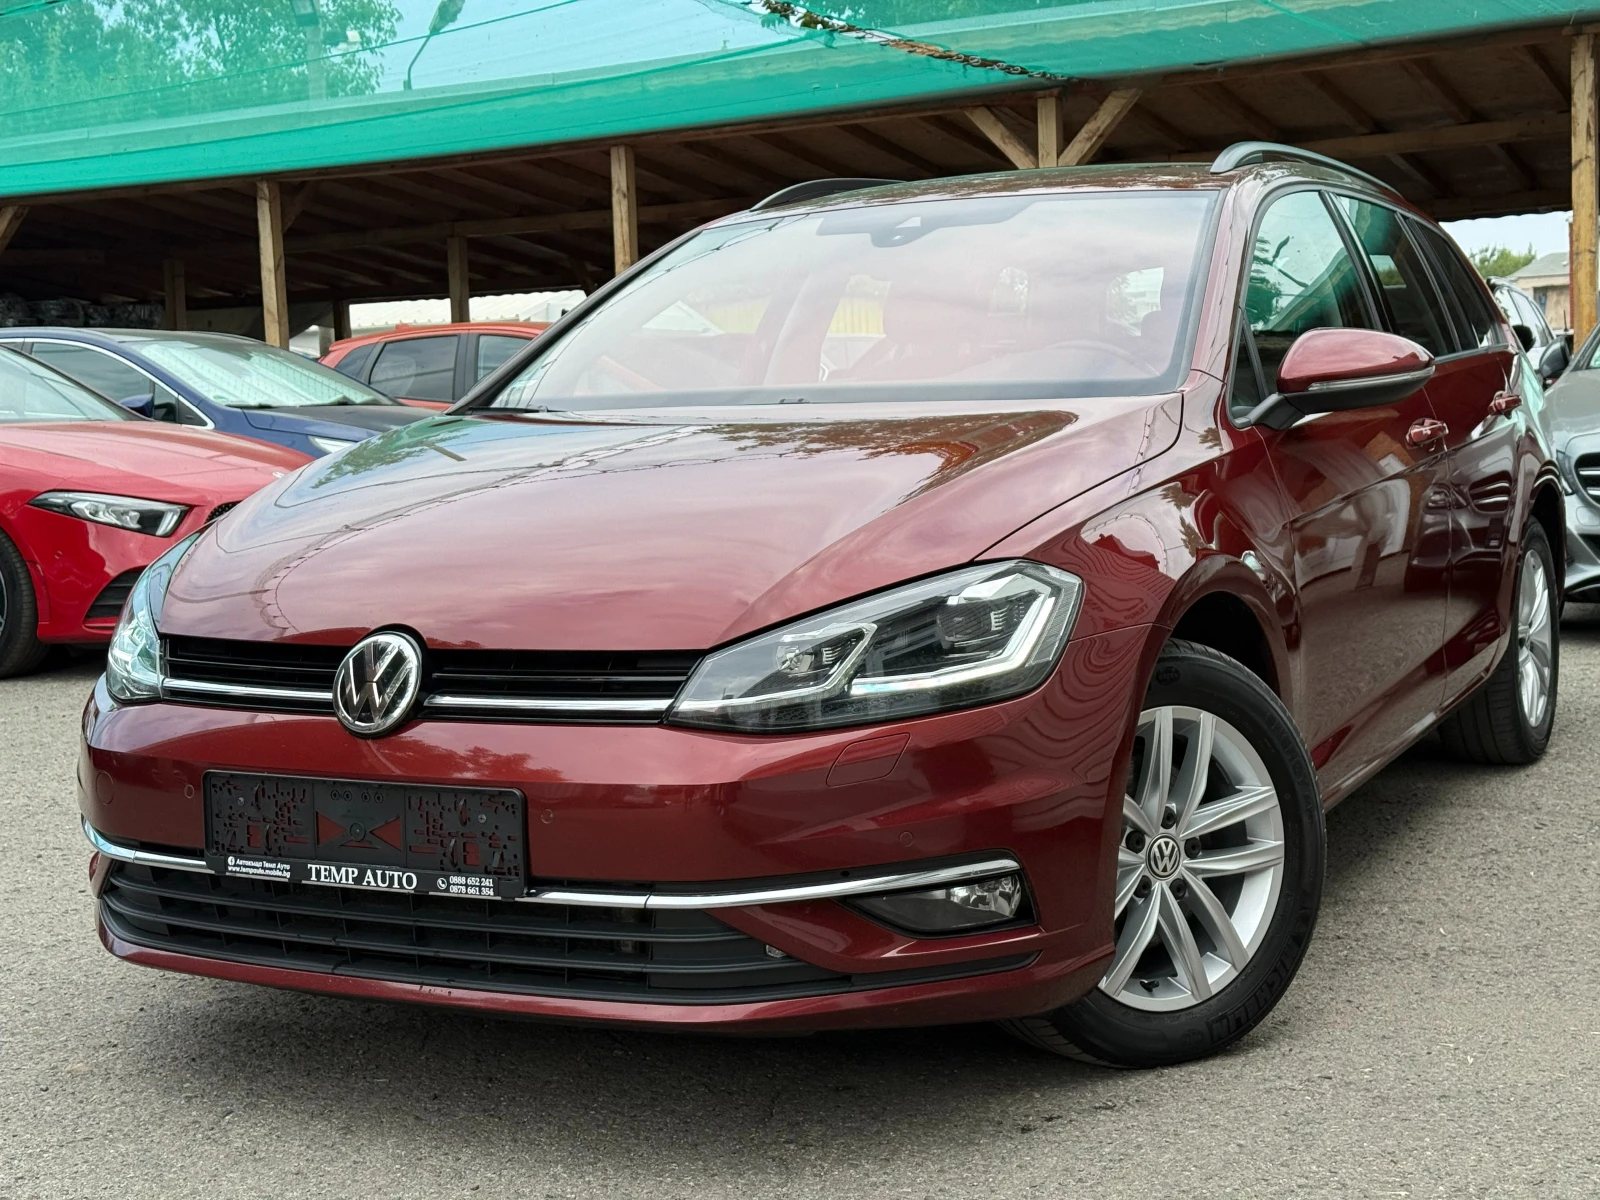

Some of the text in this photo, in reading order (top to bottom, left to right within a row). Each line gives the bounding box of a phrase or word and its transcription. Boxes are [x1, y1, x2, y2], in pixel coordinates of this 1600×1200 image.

[332, 631, 422, 733] VW
[1149, 837, 1180, 876] VW
[228, 866, 290, 878] www.tempauto.mobile.bg
[308, 864, 417, 890] TEMP AUTO
[450, 876, 493, 886] 0888 652 241
[450, 885, 494, 896] 0878 661 354
[1206, 943, 1299, 1043] MICHELIN
